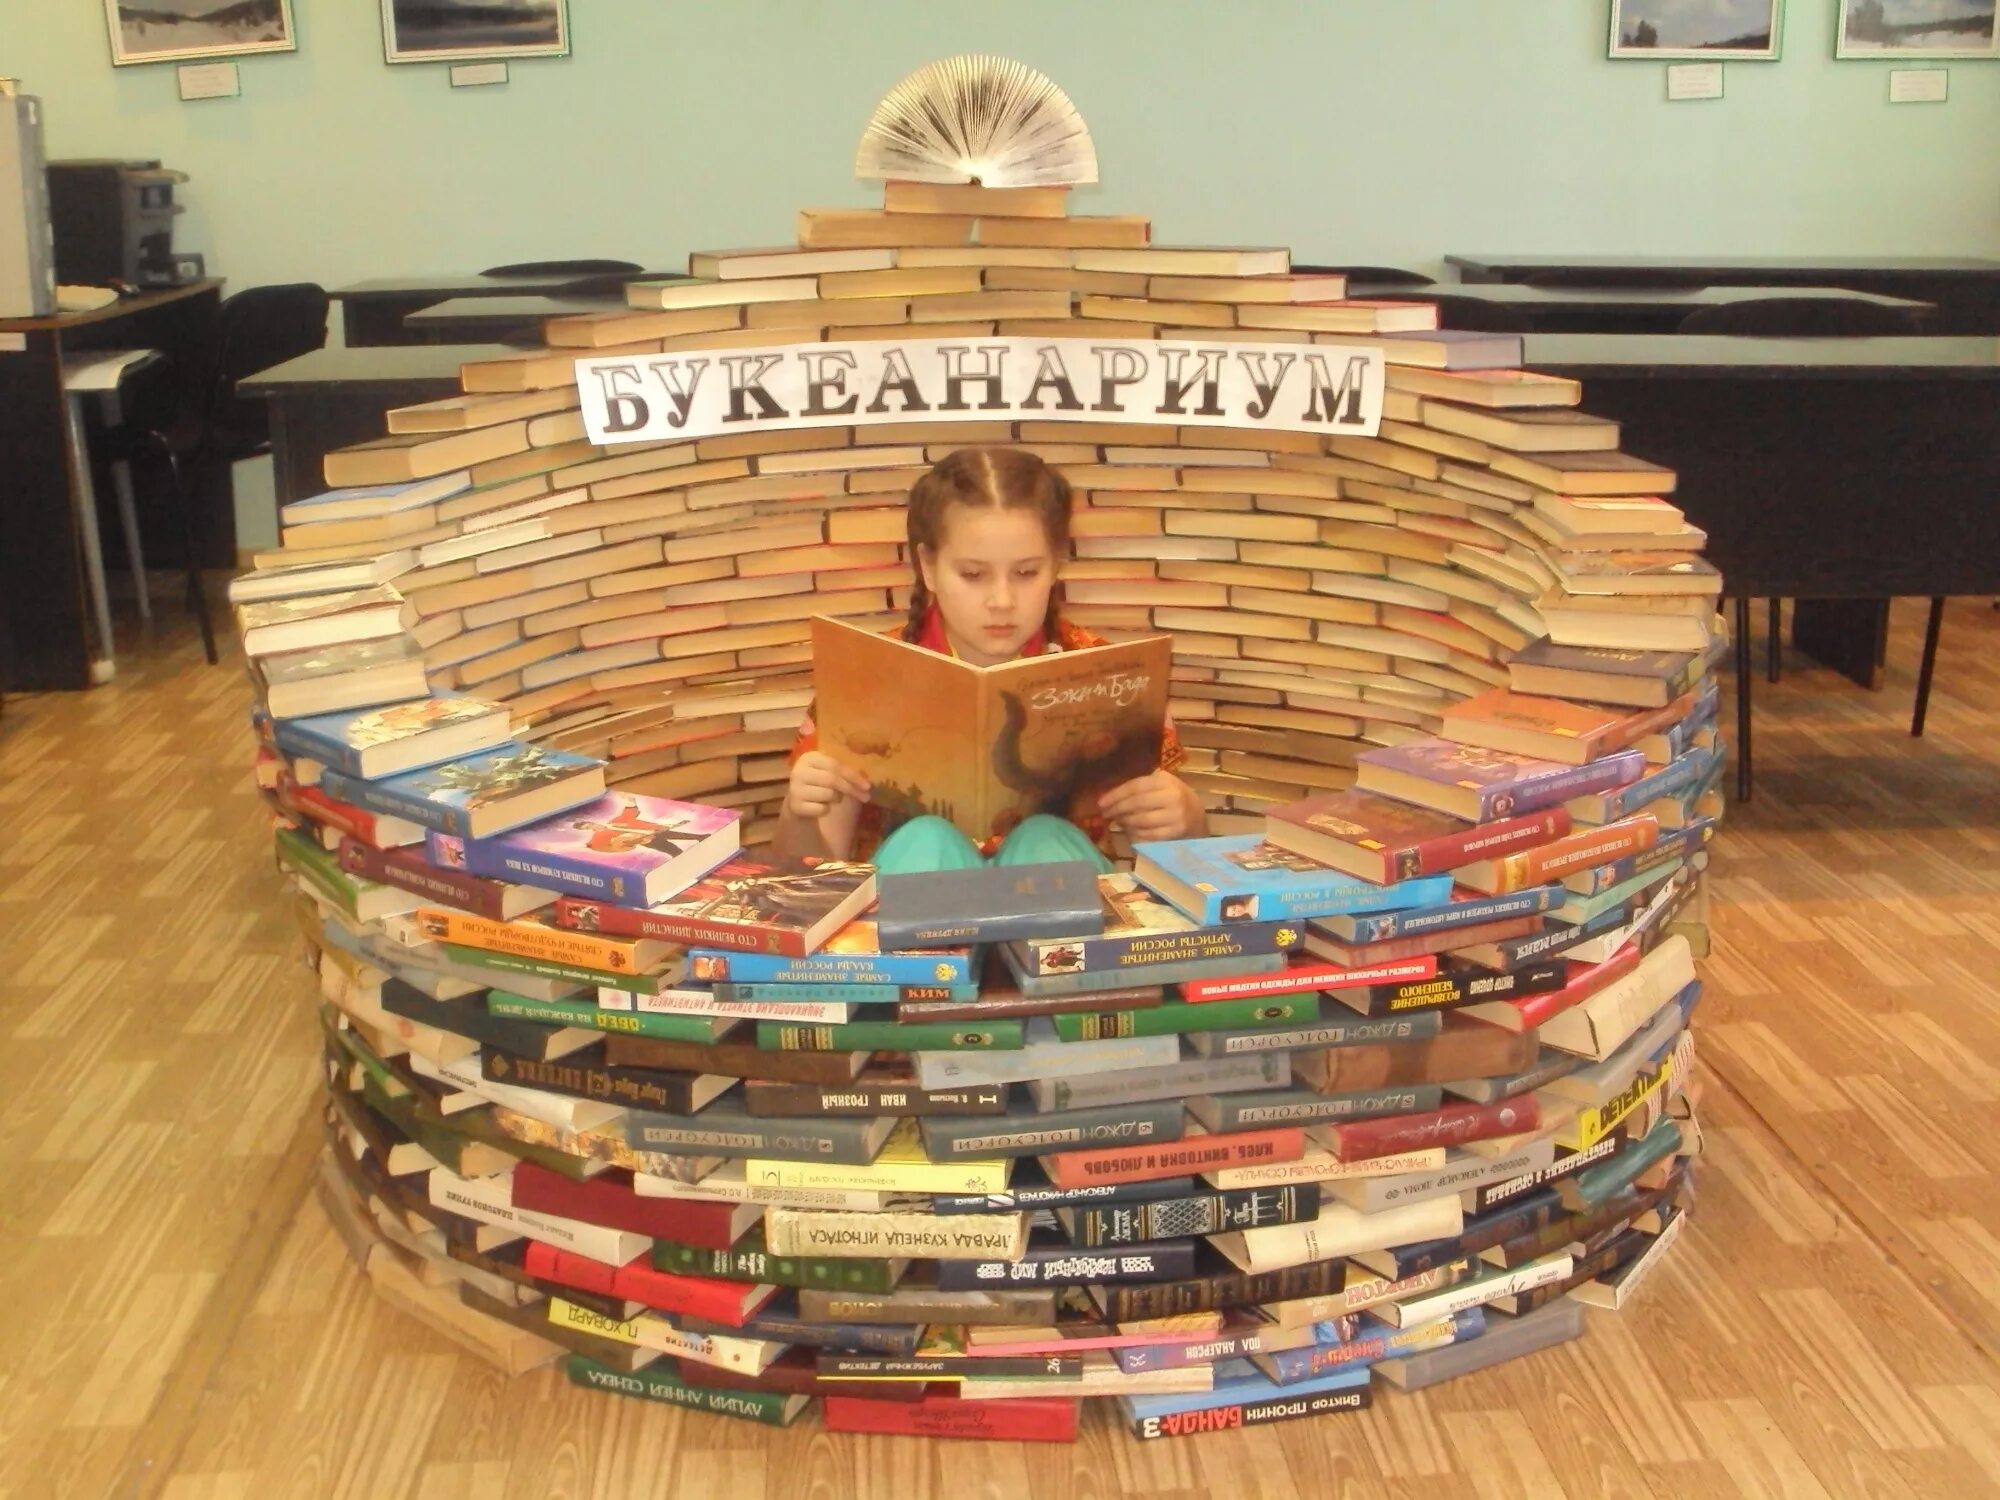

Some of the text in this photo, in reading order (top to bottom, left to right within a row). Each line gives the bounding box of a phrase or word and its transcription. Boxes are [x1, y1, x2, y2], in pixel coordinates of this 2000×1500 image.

[590, 346, 1371, 435] БУКЕАНАРИУМ
[1623, 838, 1631, 848] СТО
[562, 870, 590, 884] ВЕЛИКИХ
[592, 878, 604, 887] СТО
[1495, 901, 1519, 914] ВЕЛИКИХ
[1521, 900, 1530, 910] СТО
[461, 922, 497, 937] РОССИИ
[500, 928, 557, 948] ЧУДОТВОРЦЫ
[641, 921, 757, 945] СТО ВЕЛИКИХ ДИНАСТИЙ
[568, 938, 602, 955] СВЯТЫЕ
[1131, 933, 1231, 951] АРТИСТЫ РОССИИ
[1120, 945, 1242, 964] САМЫЕ ЗНАМЕНИТЫЕ
[791, 960, 874, 970] КЛАДЫ РОССИИ
[775, 972, 891, 982] САМЫЕ ЗНАМЕНИТЫЕ
[1201, 986, 1228, 995] НОВЫЕ
[1261, 979, 1295, 990] ОДЕЖДЫ
[1296, 978, 1312, 986] ДЛЯ
[1313, 974, 1345, 984] ЖЕНЩИН
[1347, 969, 1388, 980] ШИКАРНЫХ
[1389, 966, 1424, 976] РАЗМЕРОВ
[908, 988, 950, 998] КИМ
[1400, 981, 1452, 997] БЕШЕНОГО
[1391, 990, 1460, 1009] ВОЗВРАЩЕНИЕ
[497, 1004, 640, 1031] ОБЕД на каждый день
[755, 1004, 825, 1018] ЭНЦИКЛОПЕДИЯ
[1231, 1022, 1396, 1049] ДЖОН ГОЛСУОРСИ
[822, 1095, 868, 1110] ГРОЗНЫЙ
[881, 1095, 906, 1106] ИВАН
[1352, 1095, 1400, 1113] ДЖОН
[1243, 1103, 1345, 1120] ГОЛСУОРСИ
[1082, 1120, 1136, 1139] ДЖОН
[648, 1130, 817, 1151] ДЖОН ГОЛСУОРСИ
[957, 1131, 1073, 1150] ГОЛСУОРСИ
[1147, 1156, 1155, 1169] И
[1160, 1147, 1230, 1168] ВИНТОВКА
[1084, 1157, 1142, 1176] ЛЮБОВЬ
[1404, 1168, 1486, 1194] АЛЕКСАНДР ДЮМА
[1019, 1186, 1115, 1202] АЛЕКСАНДР НИКОЛАЕВ
[809, 1229, 878, 1246] ИГНОТАСА
[886, 1232, 947, 1246] КУЗНЕЦА
[568, 1305, 621, 1335] ХОВАРД
[665, 1337, 713, 1355] ДЕТЕКТИВ
[1186, 1337, 1261, 1359] ПОЛ АНДЕРСОН
[839, 1362, 944, 1370] ЗАРУБЕЖНЫЙ ДЕТЕКТИВ
[588, 1371, 762, 1417] ЛУЦИЙ АННЕЙ СЕНЕКА
[1312, 1394, 1361, 1409] Виктор
[1247, 1402, 1307, 1420] ПРОНИН
